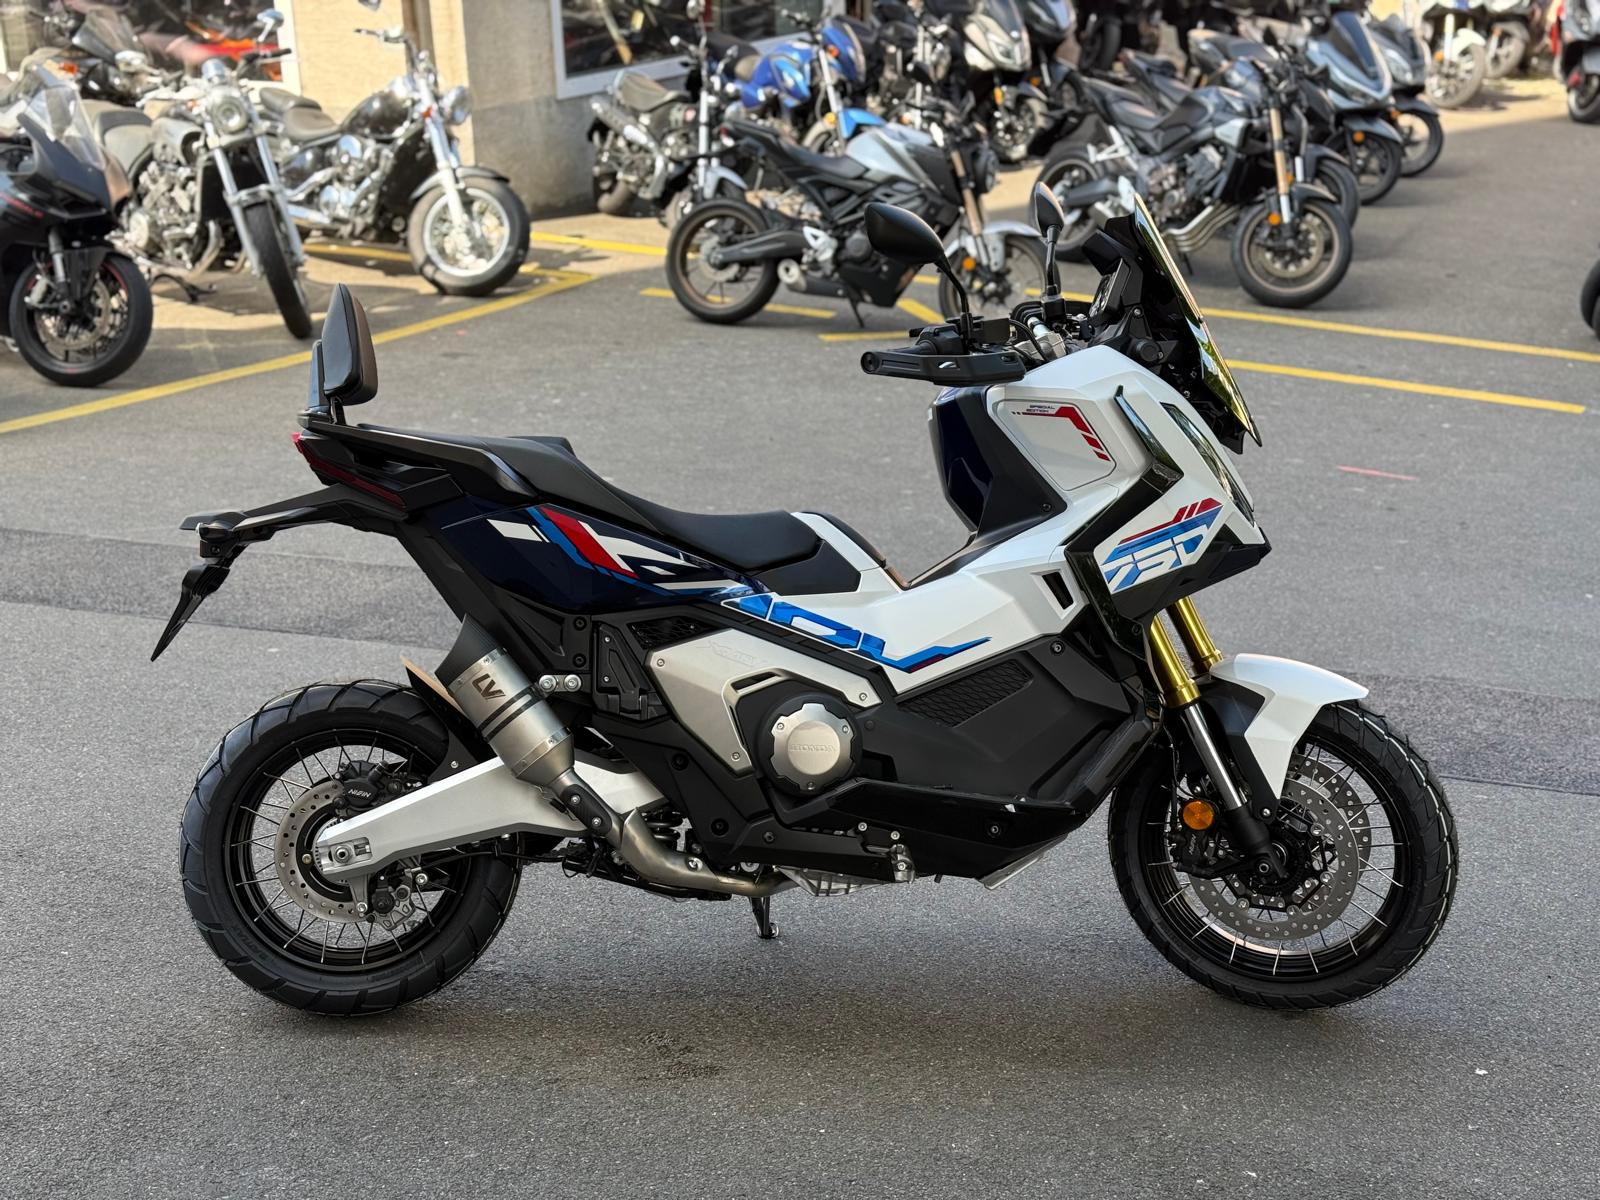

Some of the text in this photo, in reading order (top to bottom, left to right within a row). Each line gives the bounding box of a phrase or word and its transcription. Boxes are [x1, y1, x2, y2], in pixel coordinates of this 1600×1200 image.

[1100, 524, 1208, 594] 750
[471, 673, 506, 700] LV
[789, 743, 836, 753] HONDA
